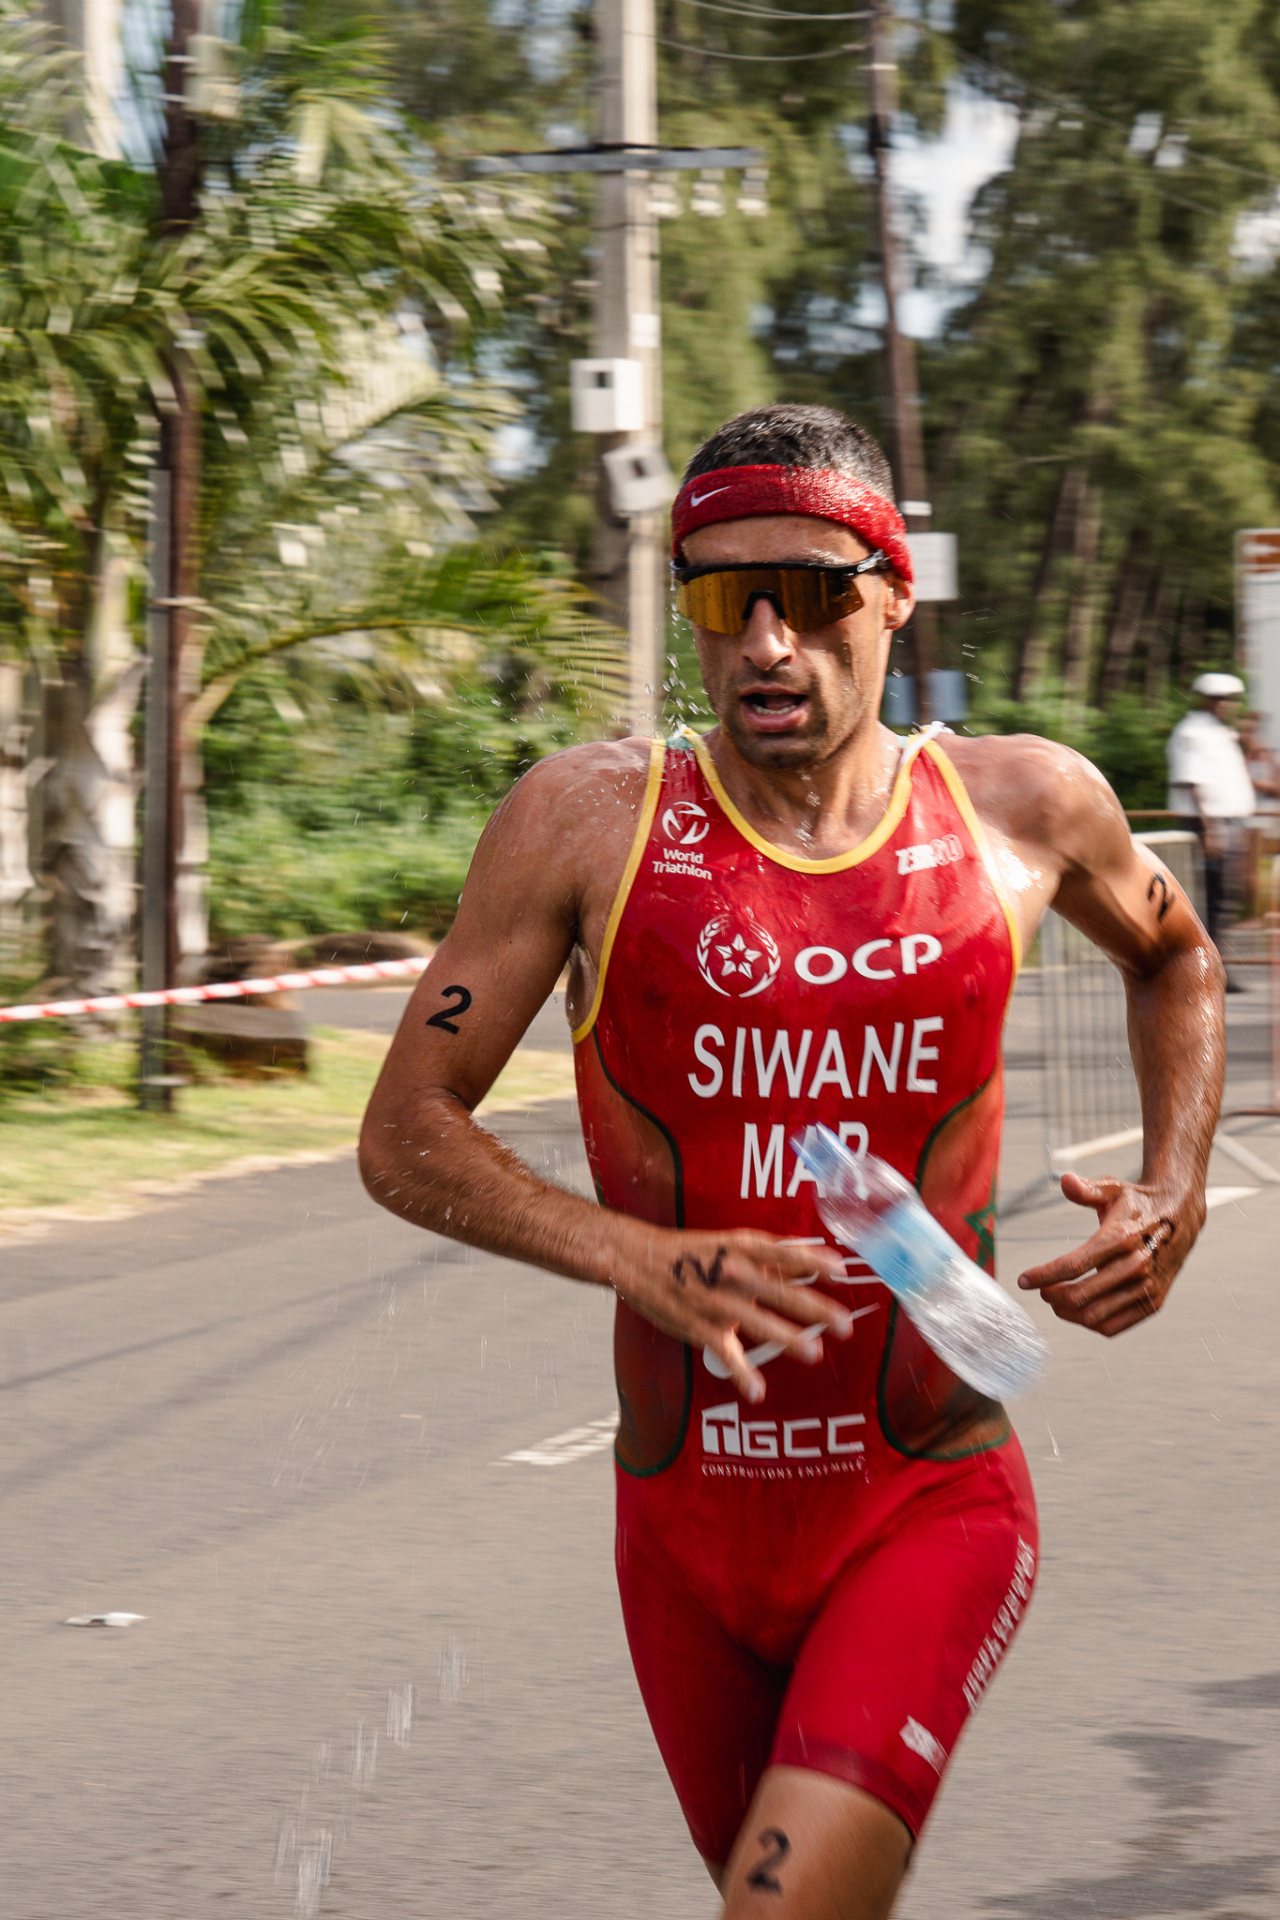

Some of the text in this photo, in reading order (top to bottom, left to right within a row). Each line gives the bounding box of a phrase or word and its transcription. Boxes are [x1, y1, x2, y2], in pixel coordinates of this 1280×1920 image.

[652, 861, 712, 881] Triathlon
[663, 848, 704, 864] World
[794, 933, 943, 985] OCP
[425, 985, 472, 1035] 2
[688, 1016, 944, 1099] SIWANE
[745, 1827, 791, 1896] 2
